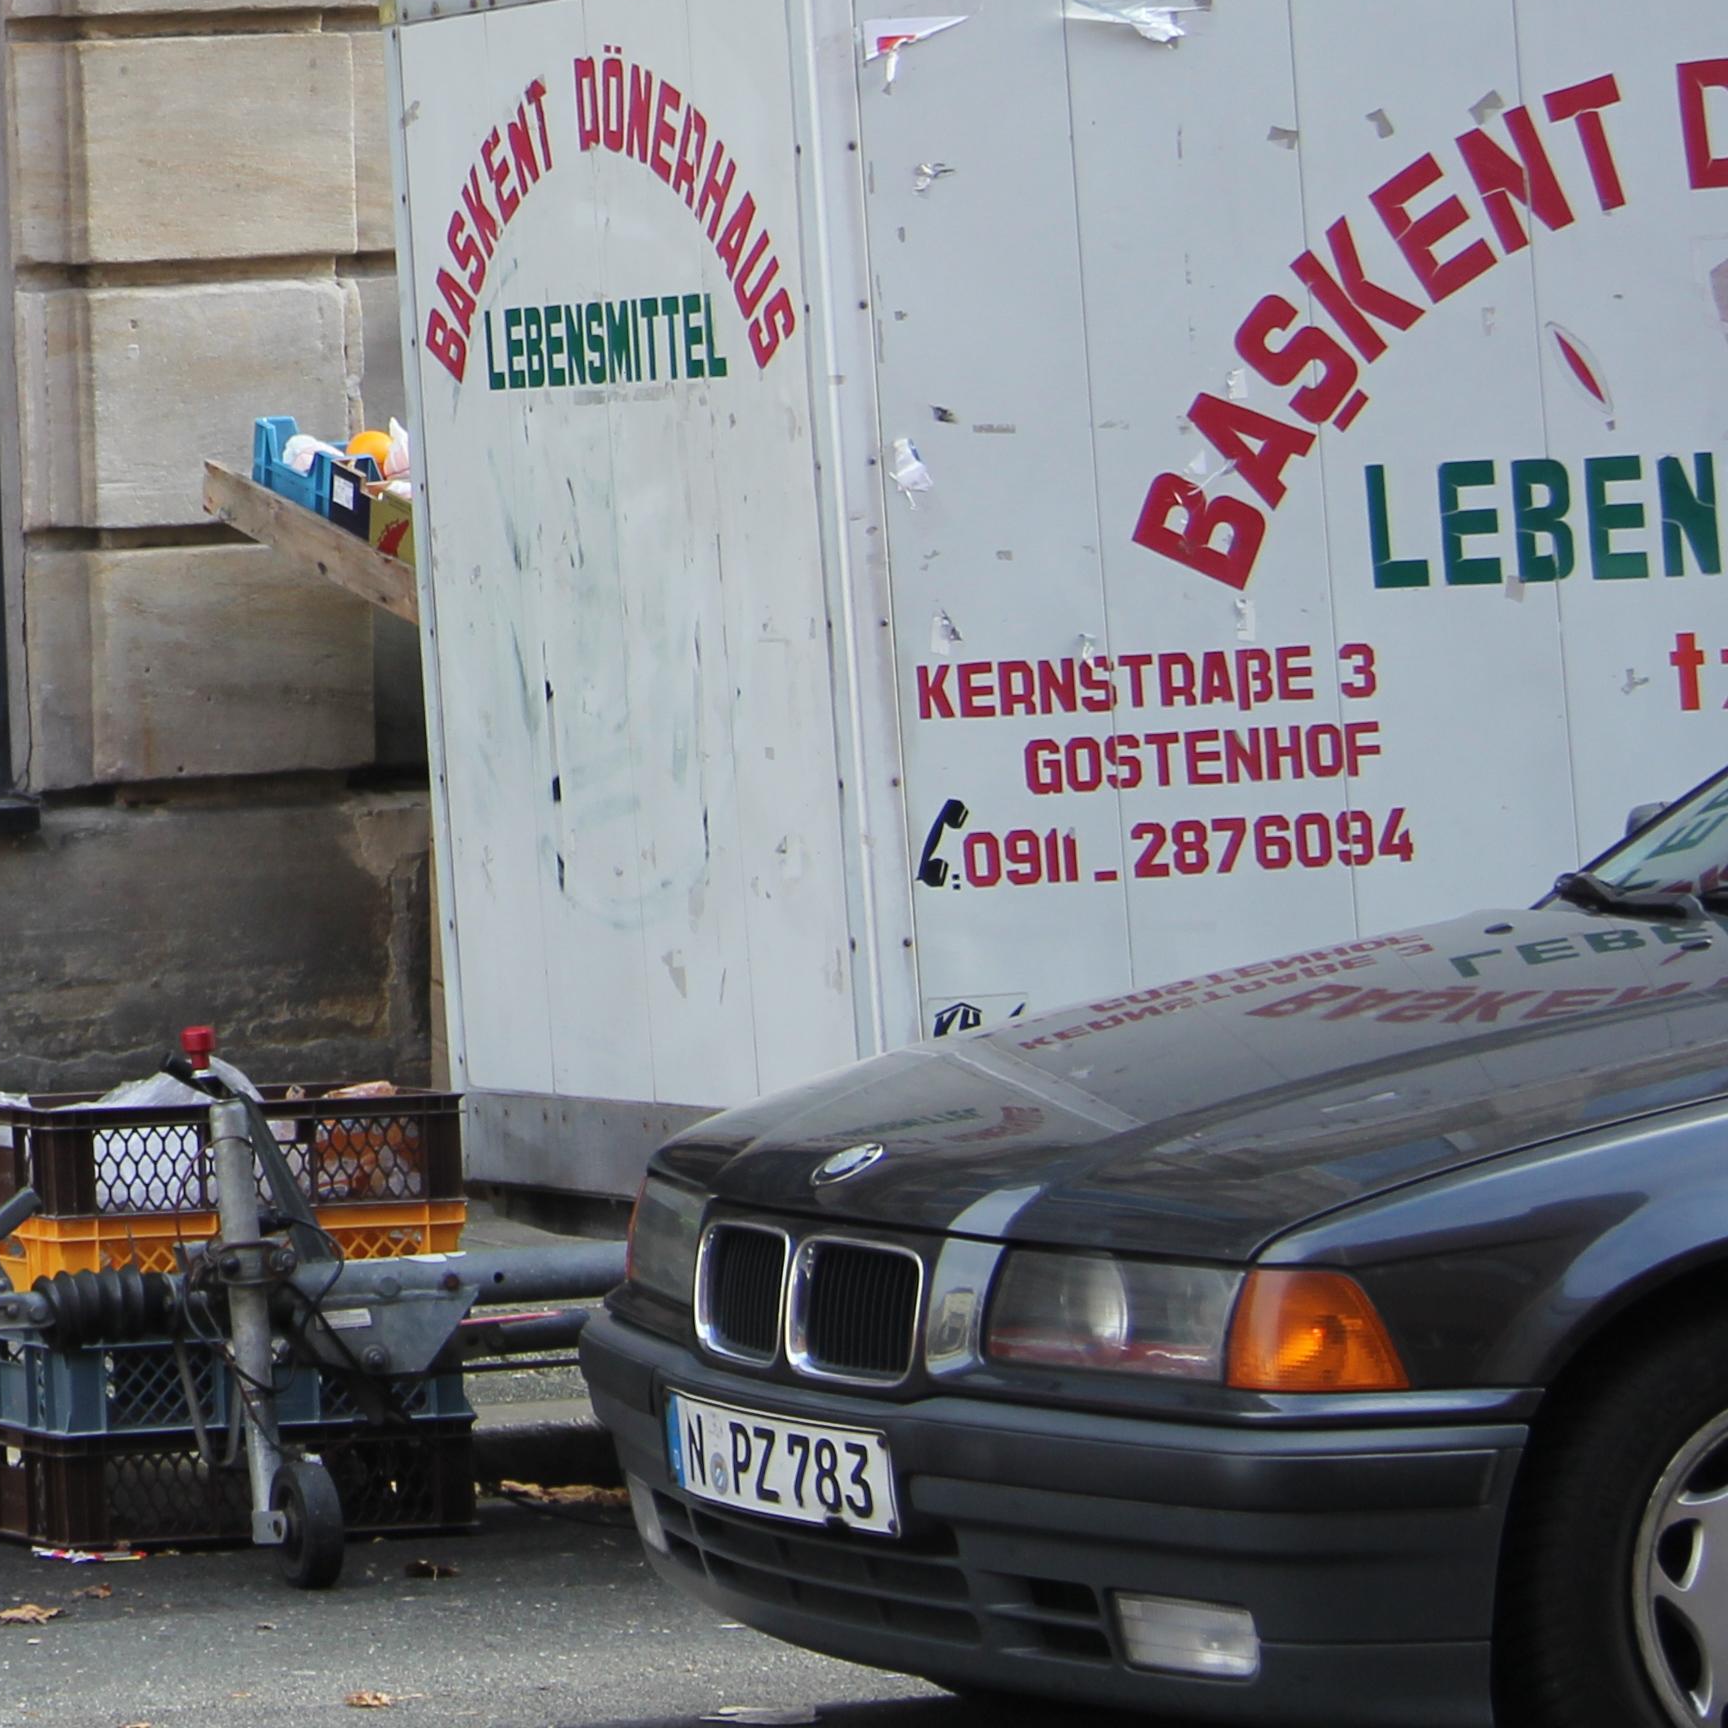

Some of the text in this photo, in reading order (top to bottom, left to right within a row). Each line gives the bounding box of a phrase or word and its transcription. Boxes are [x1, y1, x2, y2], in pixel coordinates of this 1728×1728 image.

[425, 44, 796, 384] BASKENT DÖNERHAUS
[484, 293, 729, 391] LEBENSMITTEL
[915, 642, 1378, 721] KERNSTRAßE 3
[1023, 721, 1382, 796] GOSTENHOF
[1129, 807, 1414, 880] 2876094
[686, 1408, 874, 1519] N PZ 783
